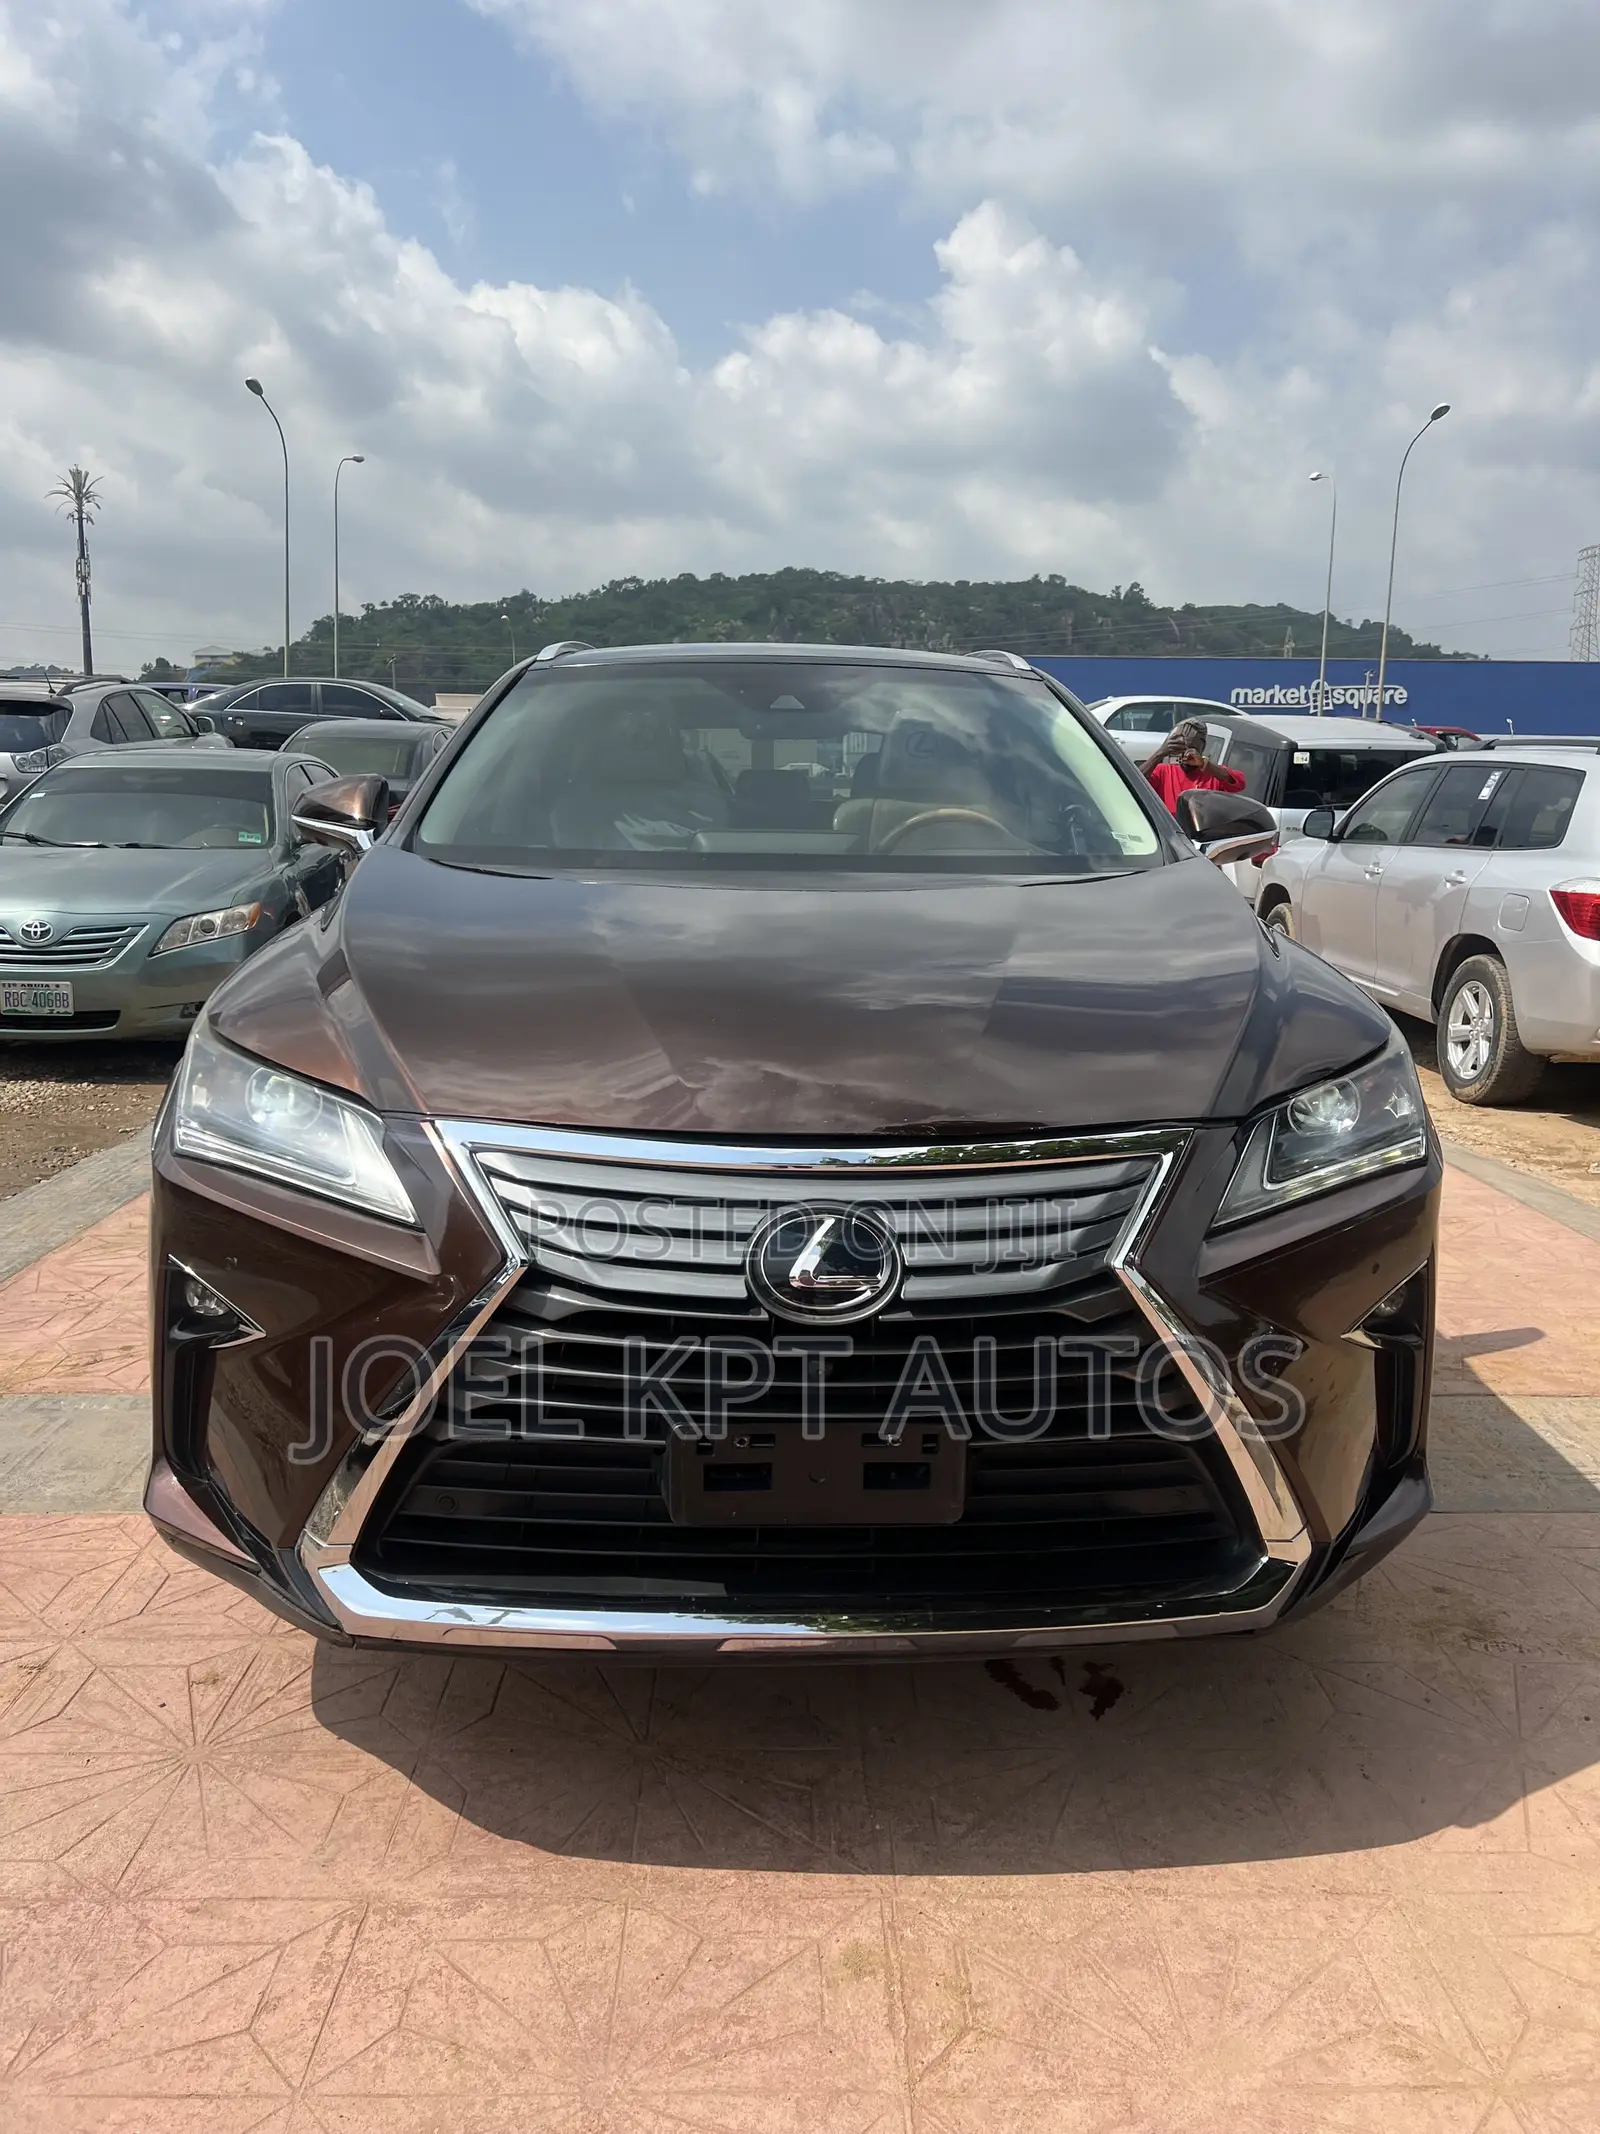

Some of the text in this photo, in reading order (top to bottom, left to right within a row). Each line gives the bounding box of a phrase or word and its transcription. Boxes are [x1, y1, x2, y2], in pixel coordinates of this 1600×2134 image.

[1231, 685, 1408, 709] market square
[4, 991, 70, 1008] RBC-406BB
